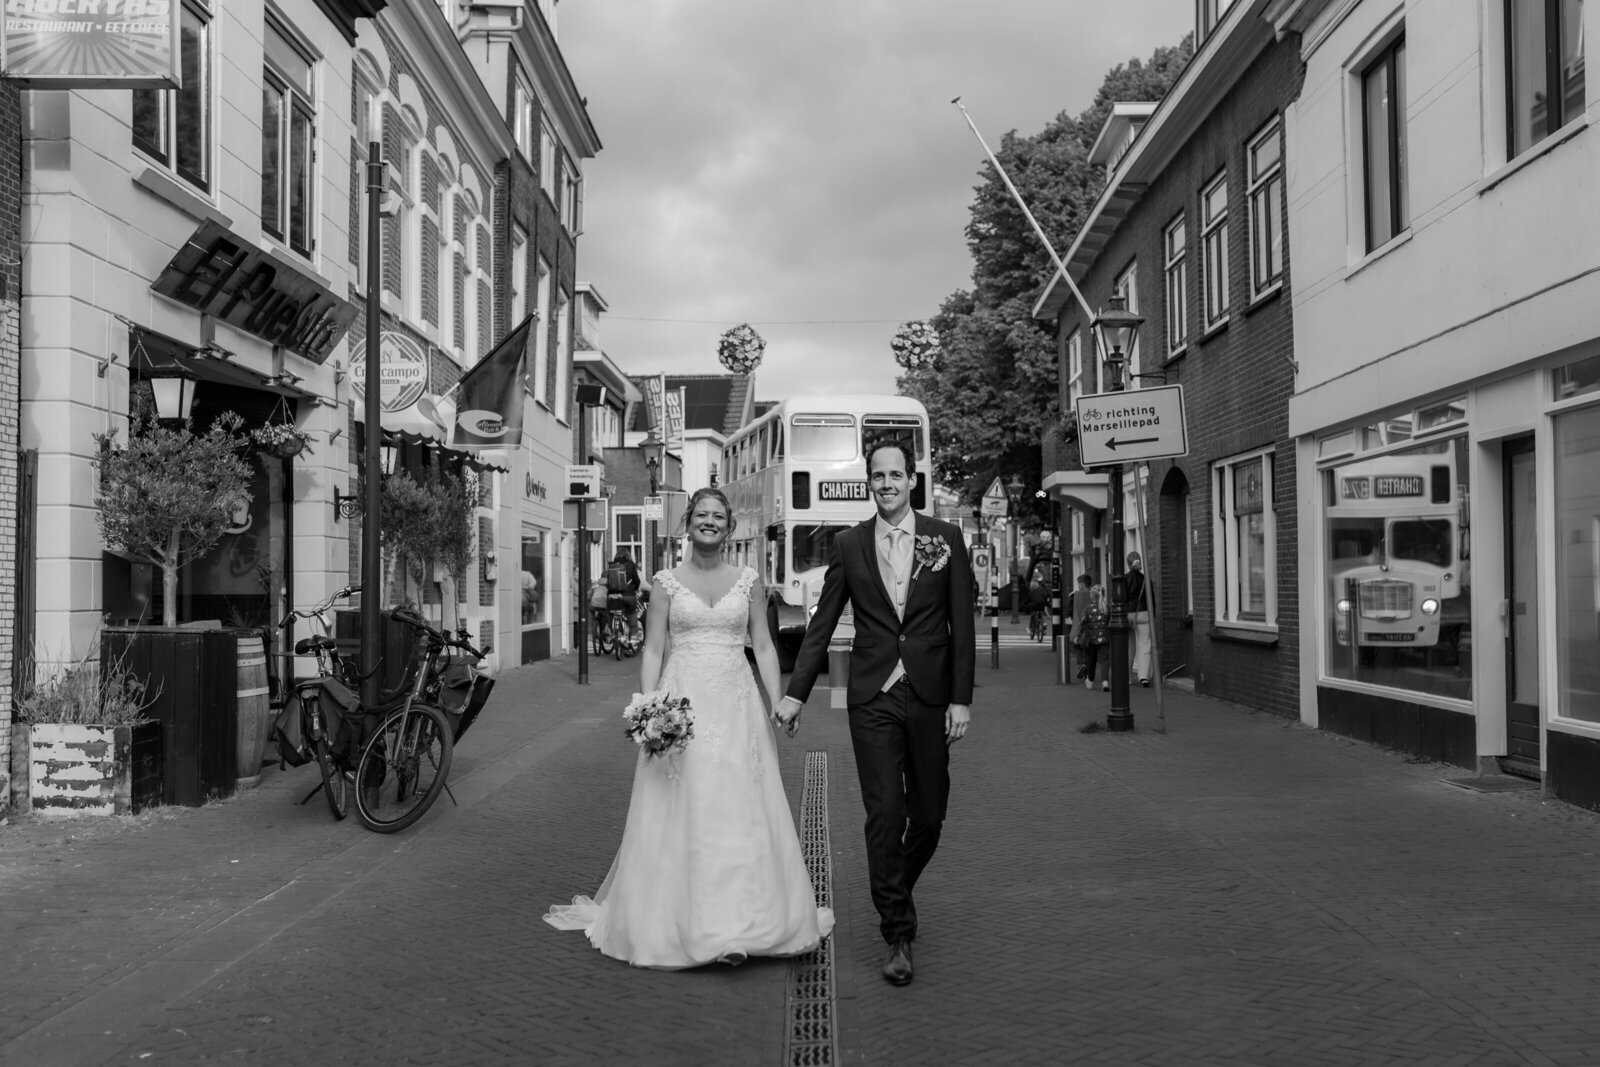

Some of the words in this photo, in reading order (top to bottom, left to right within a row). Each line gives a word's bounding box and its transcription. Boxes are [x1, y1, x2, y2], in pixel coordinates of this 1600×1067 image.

[6, 20, 94, 33] RESTAURANT
[174, 236, 249, 310] El
[1106, 406, 1155, 419] richting
[1083, 416, 1160, 433] Marseillepad
[822, 482, 867, 499] CHARTER
